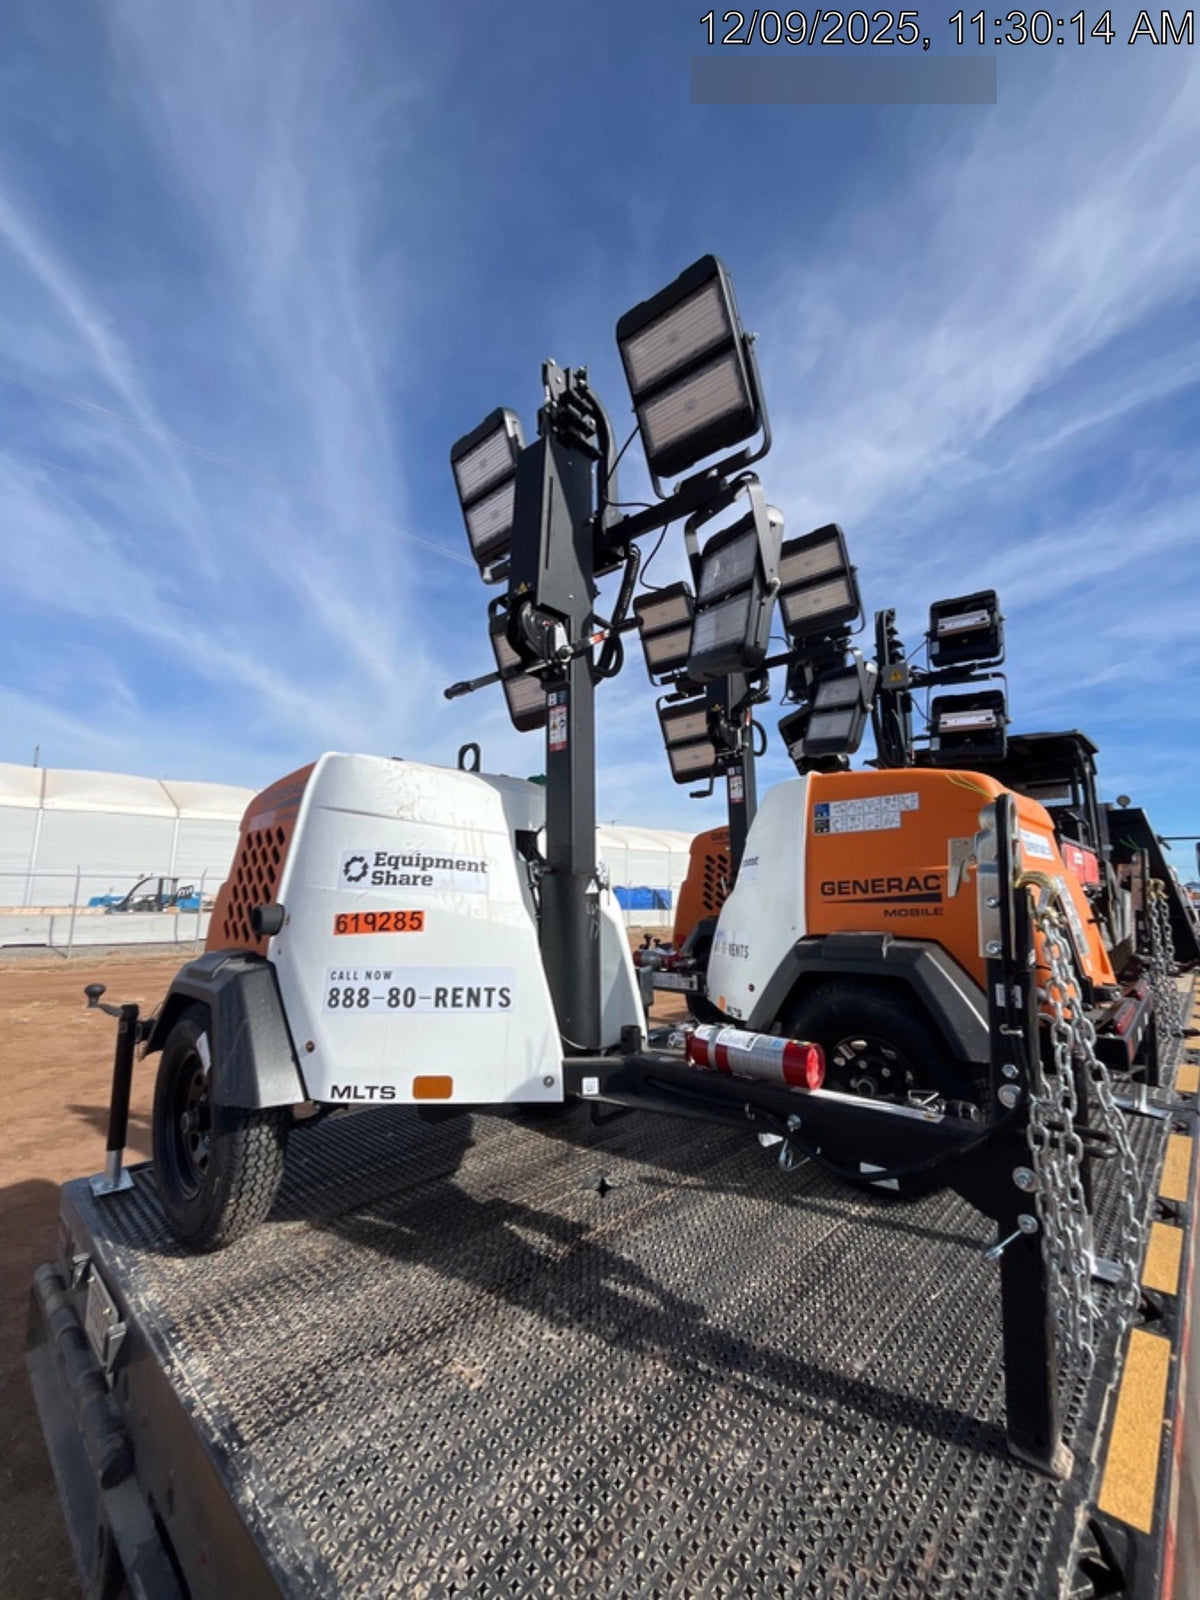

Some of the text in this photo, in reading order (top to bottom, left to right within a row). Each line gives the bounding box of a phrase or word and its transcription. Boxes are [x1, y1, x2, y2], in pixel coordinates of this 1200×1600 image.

[374, 852, 488, 874] Equipment
[371, 870, 434, 887] Share
[821, 874, 942, 896] GENERAC
[335, 910, 424, 934] 619285
[883, 907, 943, 918] MOBILE
[330, 970, 393, 982] CALL NOW
[327, 987, 512, 1009] 888-80-RENTS
[330, 1085, 396, 1100] MLTS
